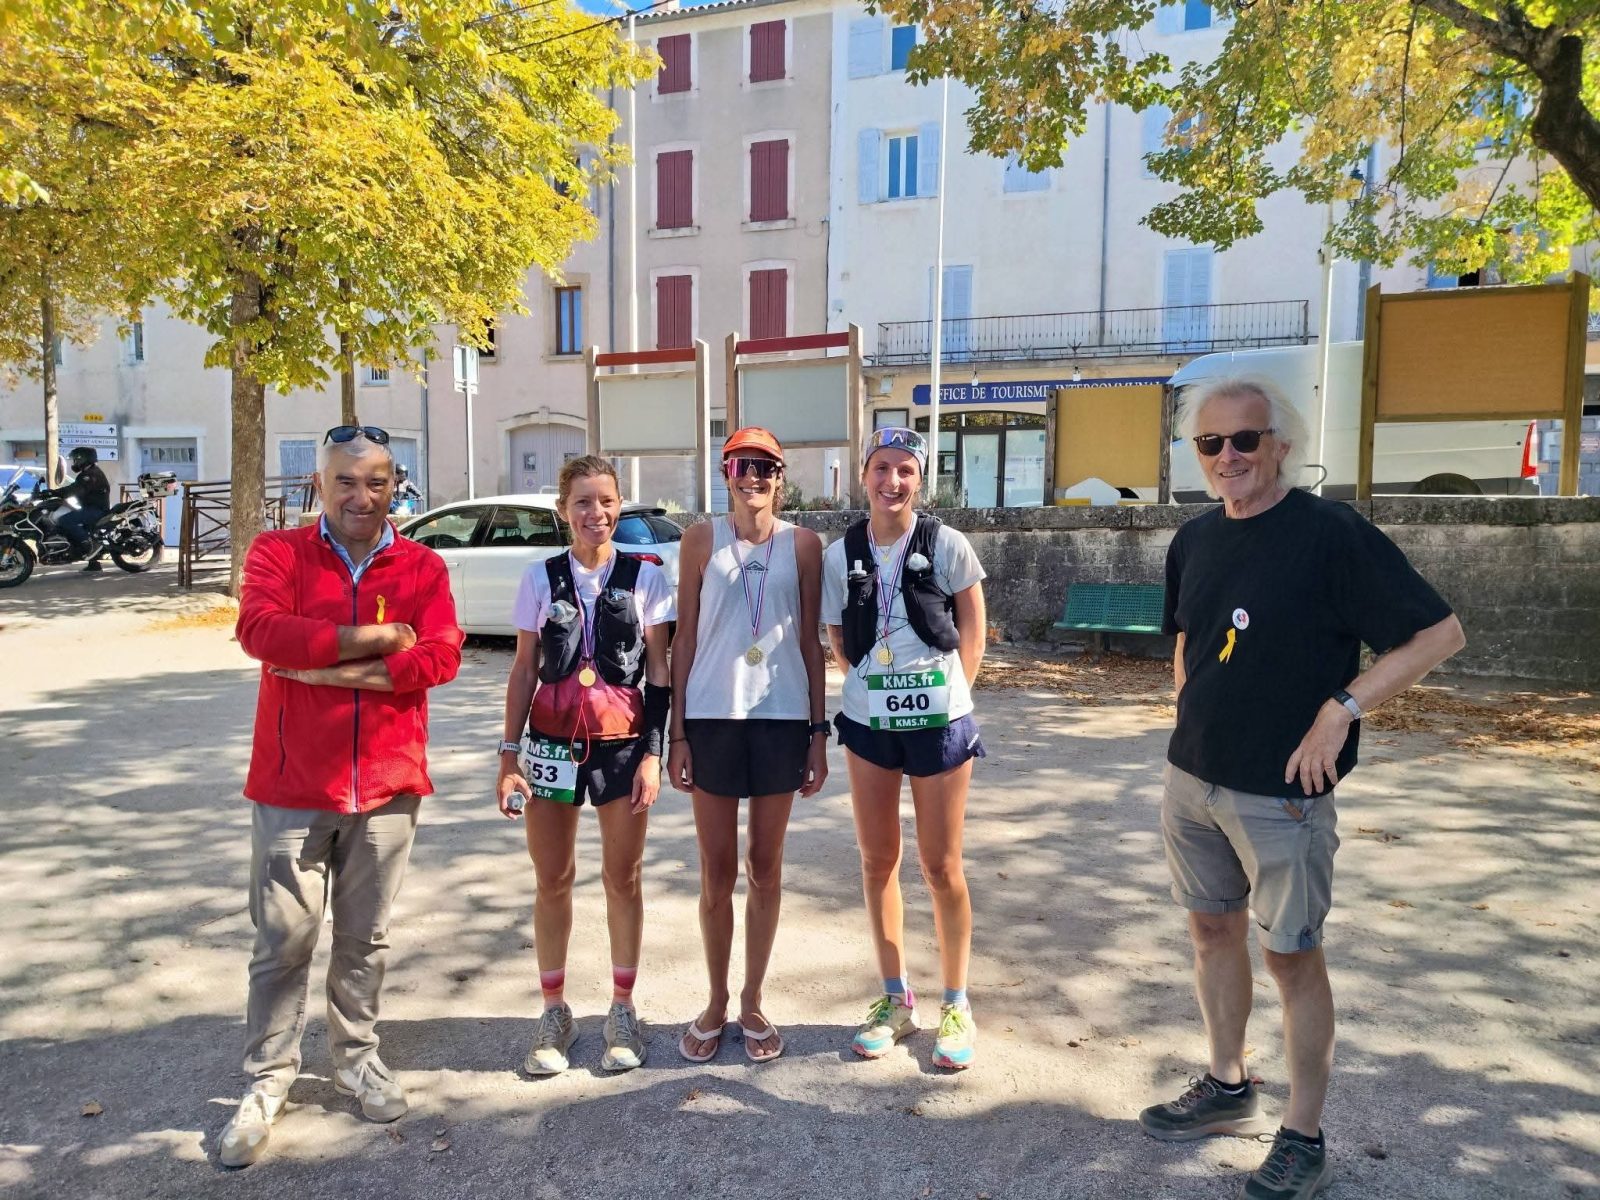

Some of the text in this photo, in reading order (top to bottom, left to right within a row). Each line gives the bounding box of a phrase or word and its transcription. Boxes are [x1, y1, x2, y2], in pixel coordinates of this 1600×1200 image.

[930, 387, 966, 400] FFICE
[972, 387, 986, 399] DE
[882, 673, 935, 688] KMS.fr
[886, 693, 930, 712] 640
[896, 718, 928, 727] KMS.fr
[532, 786, 553, 798] MS.fr
